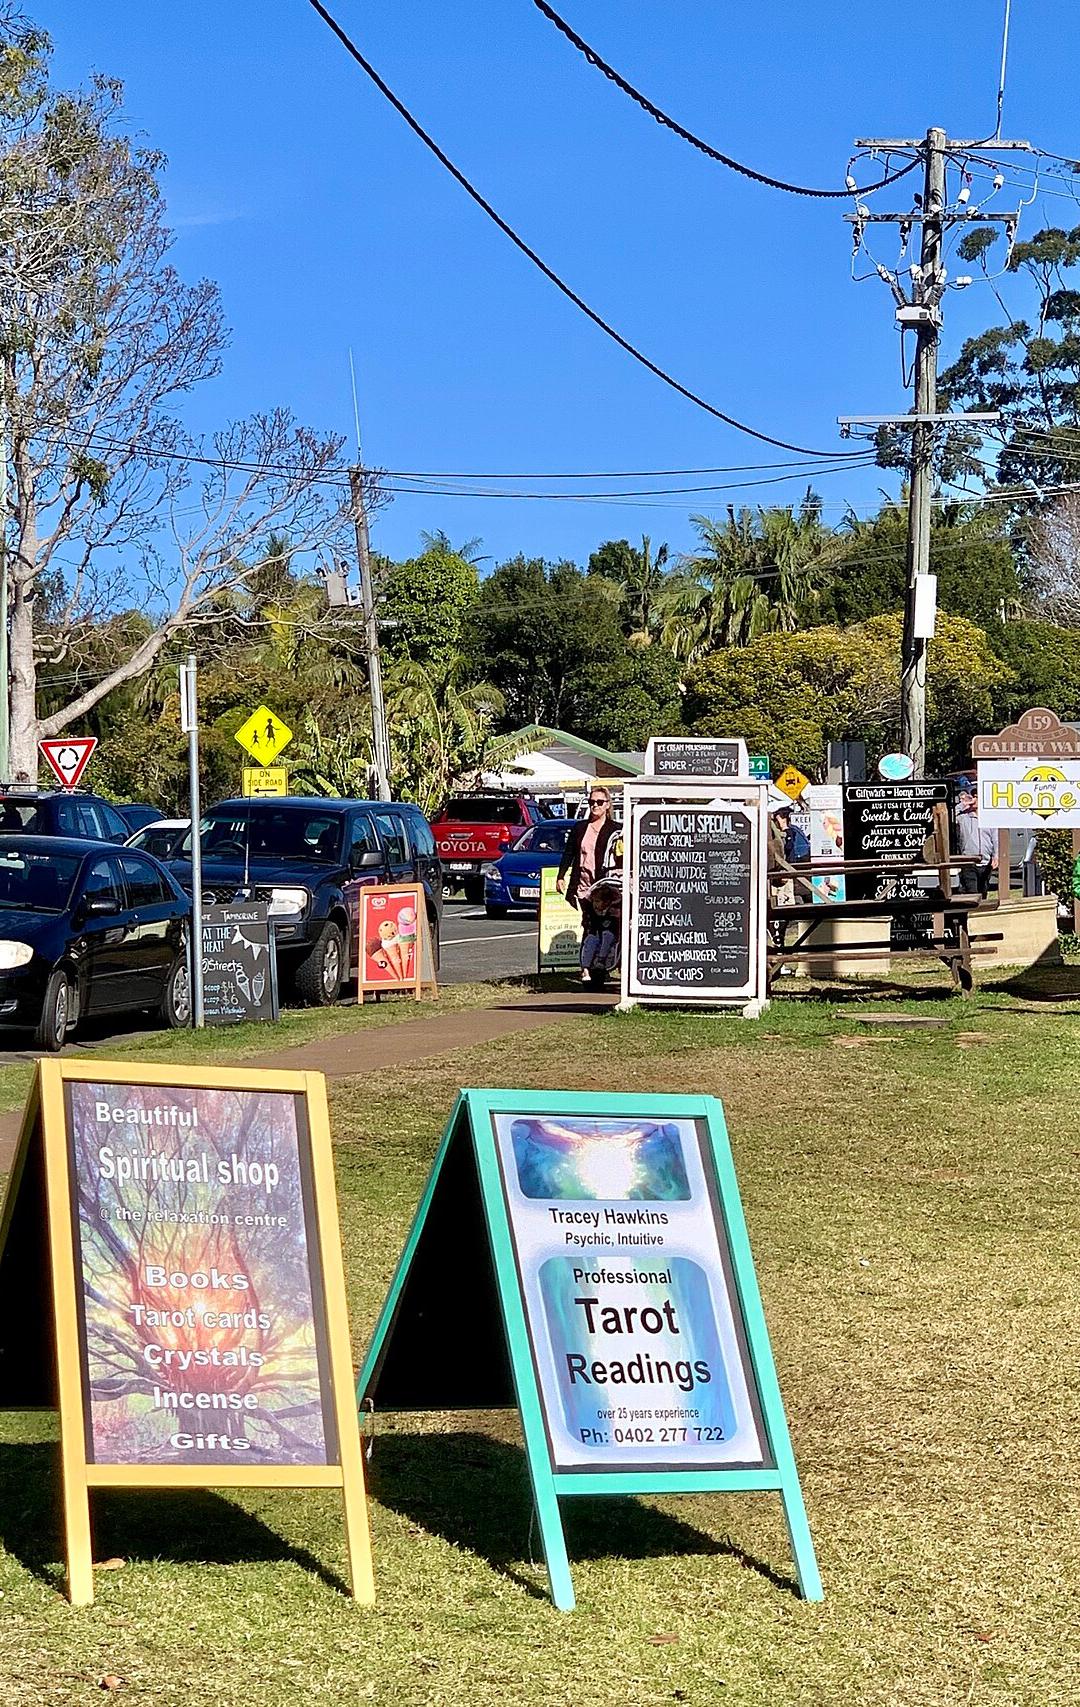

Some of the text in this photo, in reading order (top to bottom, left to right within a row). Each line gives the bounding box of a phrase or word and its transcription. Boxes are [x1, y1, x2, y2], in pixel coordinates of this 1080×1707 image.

[1026, 715, 1052, 731] 159
[657, 743, 666, 752] ICE
[978, 741, 1047, 753] GALLERY
[659, 760, 687, 771] SPIDER
[259, 770, 271, 778] ON
[247, 779, 262, 787] SIDE
[1034, 783, 1057, 792] Funny
[855, 788, 886, 800] Giftware
[893, 787, 914, 799] Home
[860, 808, 934, 823] Sweets & Candy
[660, 814, 736, 834] LUNCH SPECIAL
[870, 827, 926, 836] MALENY GOURMET
[435, 841, 487, 852] TOYOTA
[861, 835, 893, 850] Gelato
[894, 838, 901, 847] &
[640, 850, 670, 862] CHICKEN
[639, 865, 674, 878] AMERICAN
[675, 880, 709, 894] CALAMARI
[875, 885, 926, 900] Sft Serve
[220, 910, 259, 922] TAMBORINE
[638, 913, 694, 928] BEEF LASAGNA
[713, 911, 736, 921] SALAD
[202, 927, 232, 940] AT THE
[638, 931, 652, 946] PIE
[660, 931, 694, 946] SAUSAGE
[203, 940, 225, 953] HEAT!
[638, 950, 668, 963] CLASSIC
[668, 949, 717, 962] HAMBURGER
[95, 1101, 198, 1127] Beautiful
[99, 1146, 280, 1193] Spiritual shop
[100, 1207, 288, 1227] @ the relaxation centre
[548, 1208, 669, 1228] Tracey Hawkins
[565, 1232, 664, 1247] Psychic, Intuitive
[145, 1265, 250, 1290] Books
[573, 1268, 673, 1284] Professional
[130, 1304, 271, 1330] Tarot cards
[574, 1298, 680, 1334] Tarot
[143, 1344, 265, 1370] Crystals
[566, 1353, 712, 1392] Readings
[153, 1386, 259, 1410] Incense
[597, 1406, 700, 1421] over 25 years experience
[170, 1433, 251, 1450] Gifts
[580, 1427, 725, 1443] Ph: 0402 277 722
